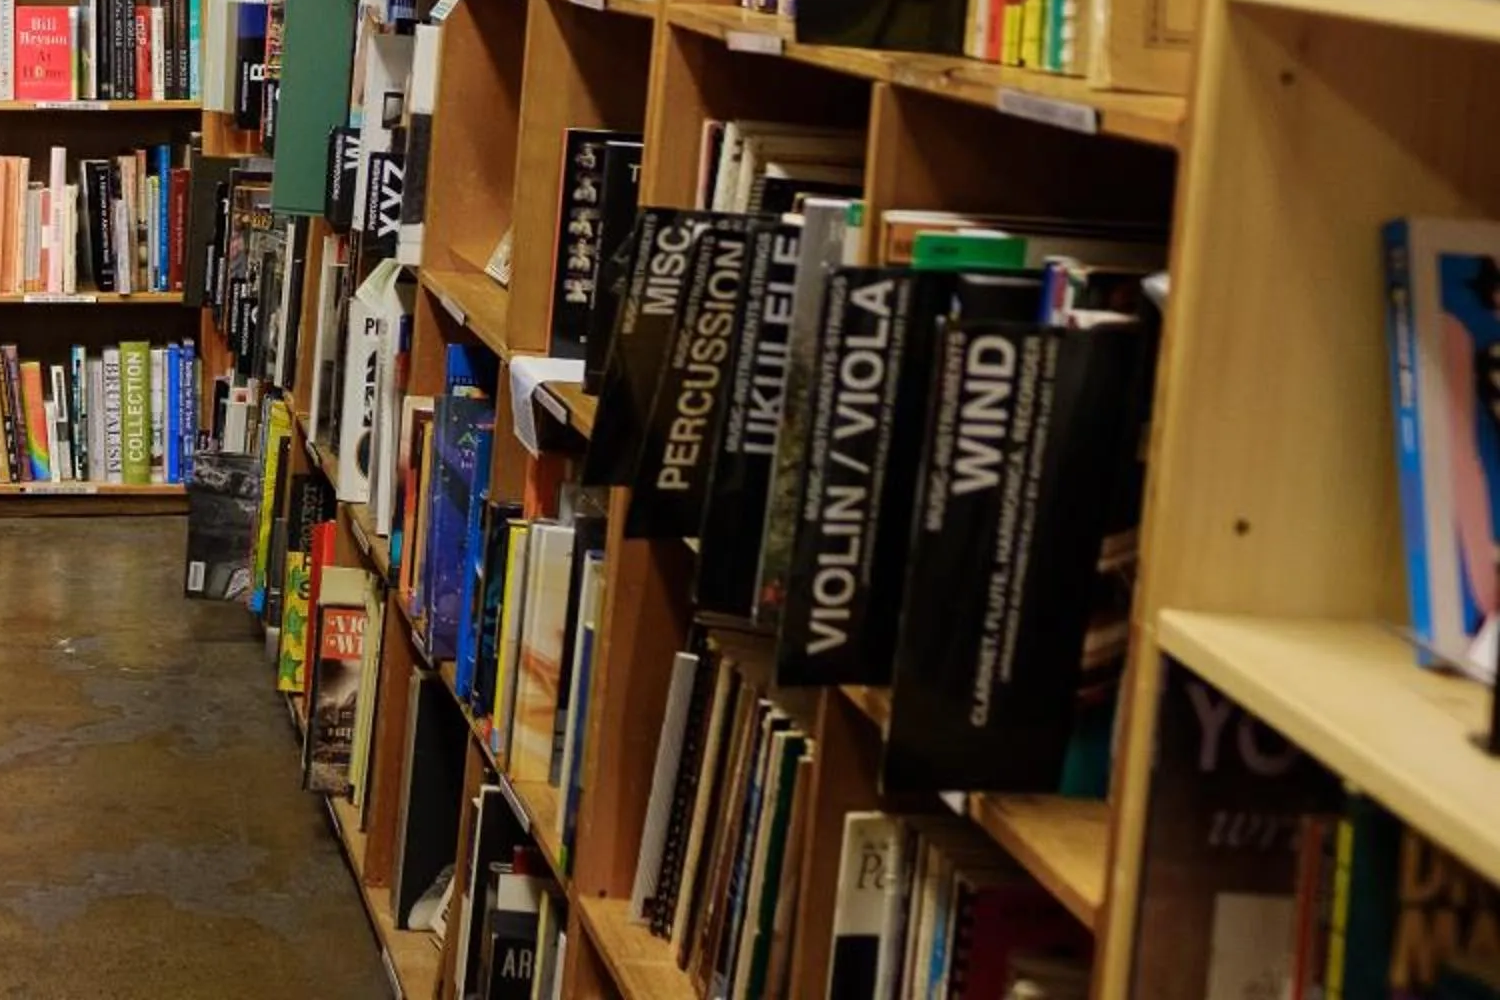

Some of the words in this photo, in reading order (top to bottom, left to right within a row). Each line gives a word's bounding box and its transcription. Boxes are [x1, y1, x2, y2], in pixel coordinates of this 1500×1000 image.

[19, 30, 67, 46] Bryson
[31, 17, 57, 31] Bill
[642, 218, 695, 316] MISC.
[127, 351, 145, 462] COLLECTION
[657, 239, 745, 490] PERCUSSION
[833, 279, 895, 441] VIOLA
[950, 334, 1018, 496] WIND
[105, 361, 121, 475] BRUTALISM
[806, 486, 867, 656] VIOLIN
